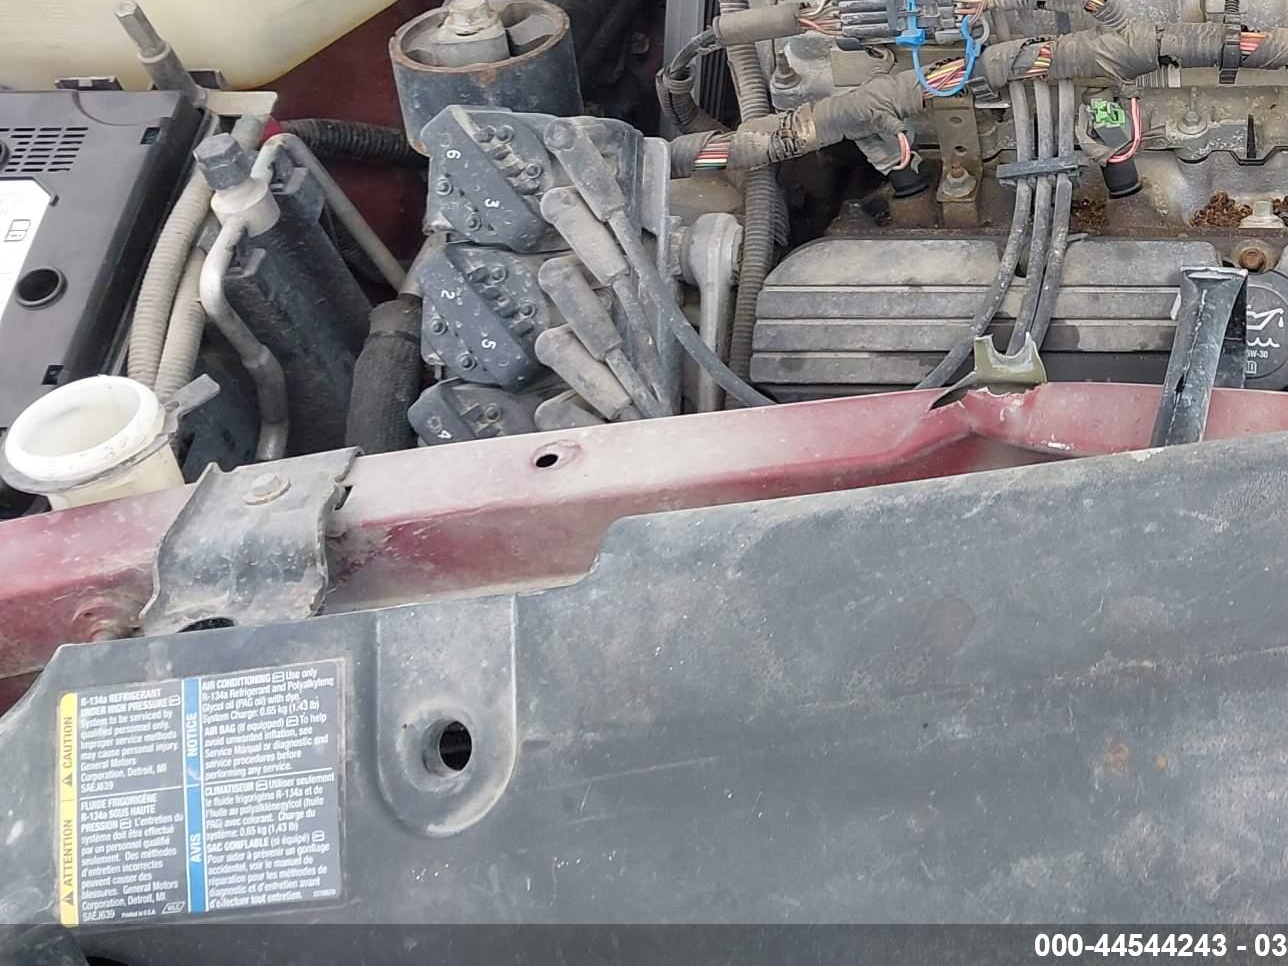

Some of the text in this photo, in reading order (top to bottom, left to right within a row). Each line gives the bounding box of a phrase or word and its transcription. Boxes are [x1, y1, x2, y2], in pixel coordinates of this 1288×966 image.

[446, 150, 460, 159] 6
[484, 198, 500, 208] 3
[440, 290, 455, 299] 2
[482, 338, 496, 350] 5
[437, 430, 452, 438] 4
[216, 674, 270, 688] CONDITIONING
[300, 669, 318, 680] only
[108, 689, 160, 702] REFRIGERANT
[230, 686, 270, 699] Refrigerant
[80, 706, 106, 716] UNDER
[127, 698, 168, 711] PRESSURE
[236, 698, 254, 709] (PAG
[254, 697, 265, 707] oil)
[267, 695, 283, 704] with
[202, 711, 228, 723] System
[246, 718, 284, 732] equipped)
[310, 714, 327, 724] help
[187, 713, 198, 757] NOTICE
[62, 716, 72, 768] CAUTION
[204, 746, 232, 757] Service
[234, 743, 262, 753] Manual
[272, 737, 312, 750] diagnostic
[80, 760, 108, 770] General
[204, 750, 302, 768] service procedures before
[204, 767, 245, 781] performing
[276, 788, 303, 798] R-134a
[81, 799, 106, 810] FLUIDE
[80, 805, 156, 821] R-134a SOUS HAUTE
[278, 809, 304, 822] Charge
[80, 820, 118, 832] PRESSION
[190, 833, 201, 863] AVIS
[224, 838, 269, 850] GONFLABLE
[63, 819, 73, 887] ATTENTION
[207, 854, 224, 863] Pour
[273, 856, 302, 867] manuel
[122, 883, 151, 894] General
[152, 880, 178, 890] Motors
